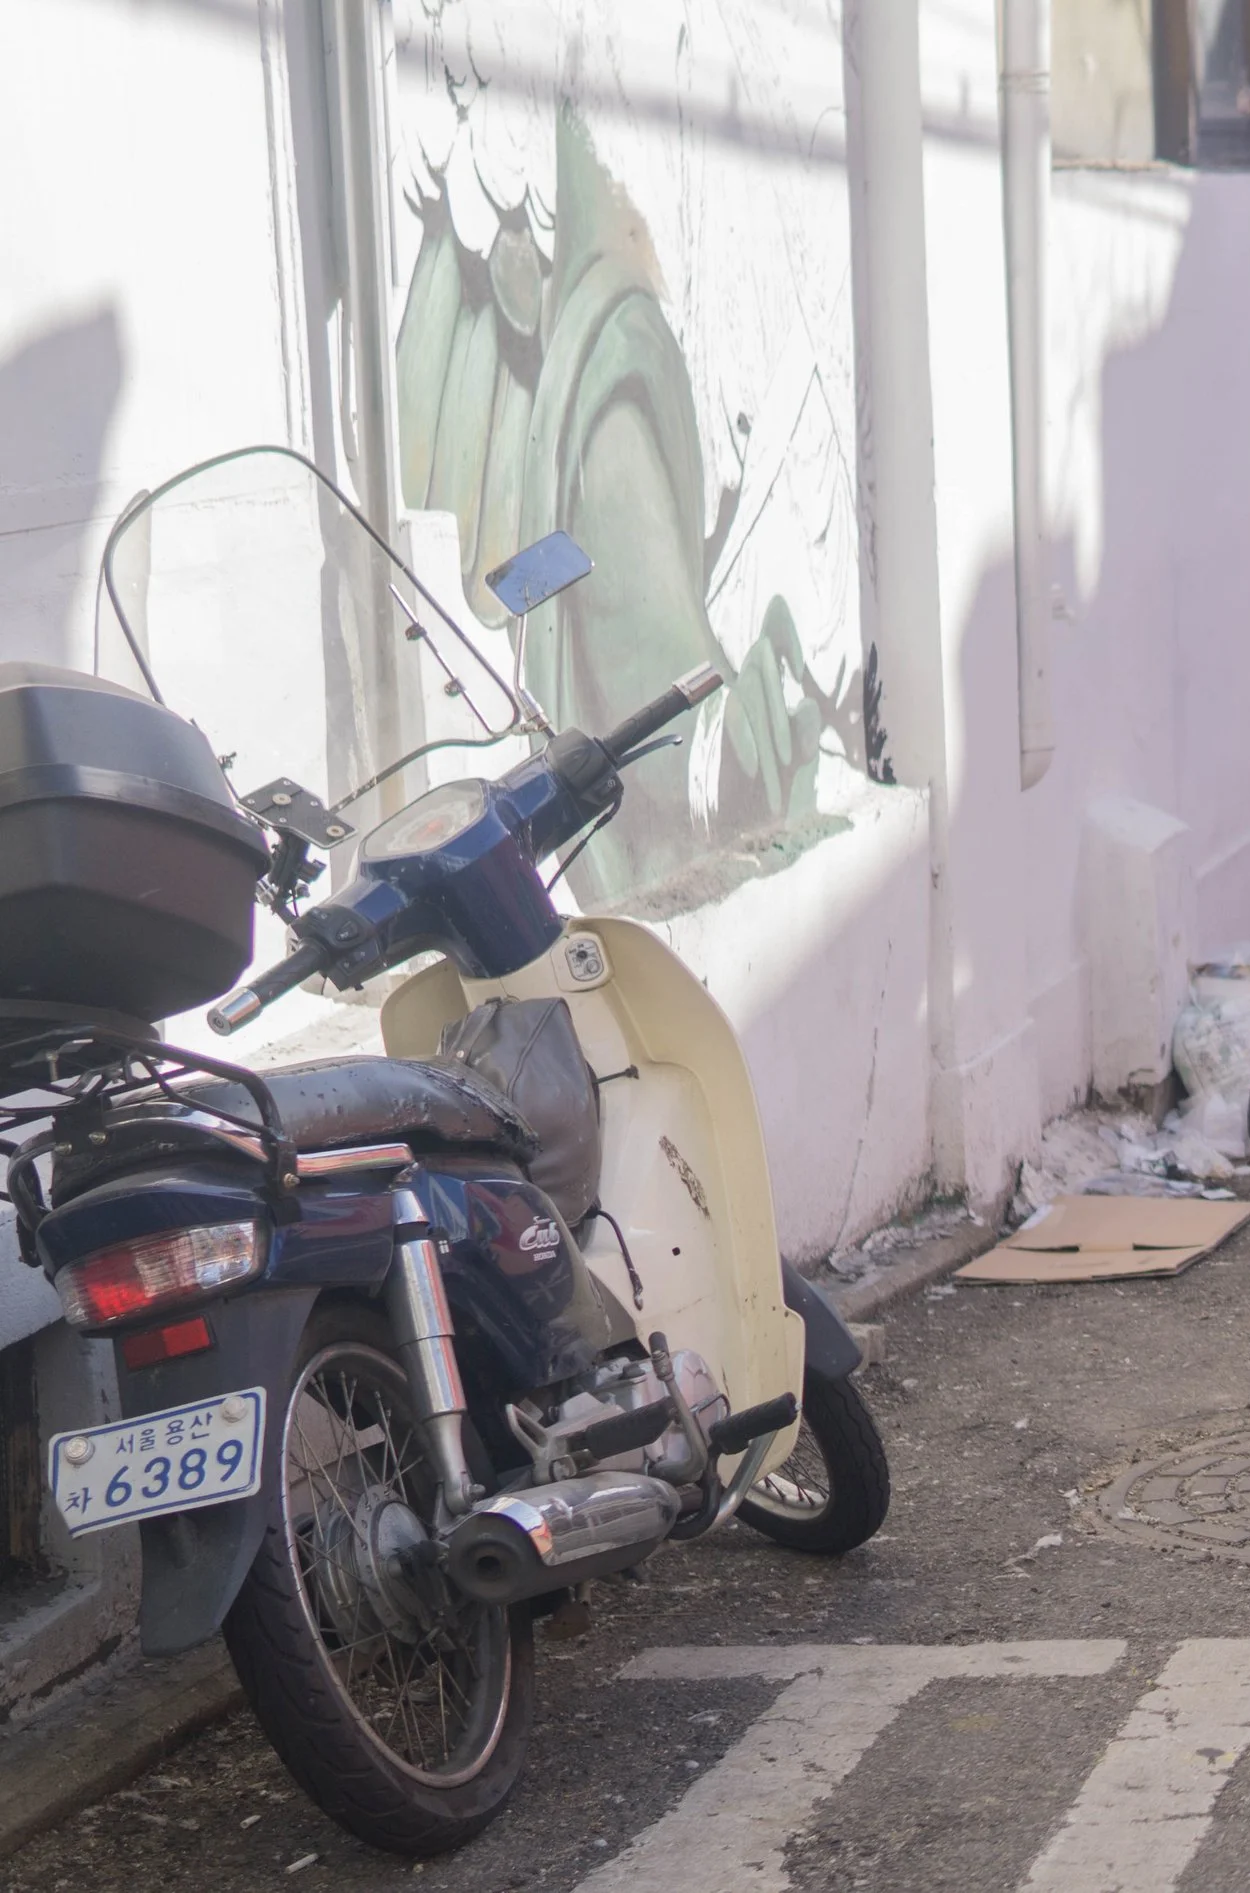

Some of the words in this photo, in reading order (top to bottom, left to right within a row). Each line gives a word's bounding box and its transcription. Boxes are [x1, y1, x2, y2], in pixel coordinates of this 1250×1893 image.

[519, 1222, 560, 1251] Cub
[64, 1487, 92, 1514] 차
[105, 1439, 244, 1507] 6389
